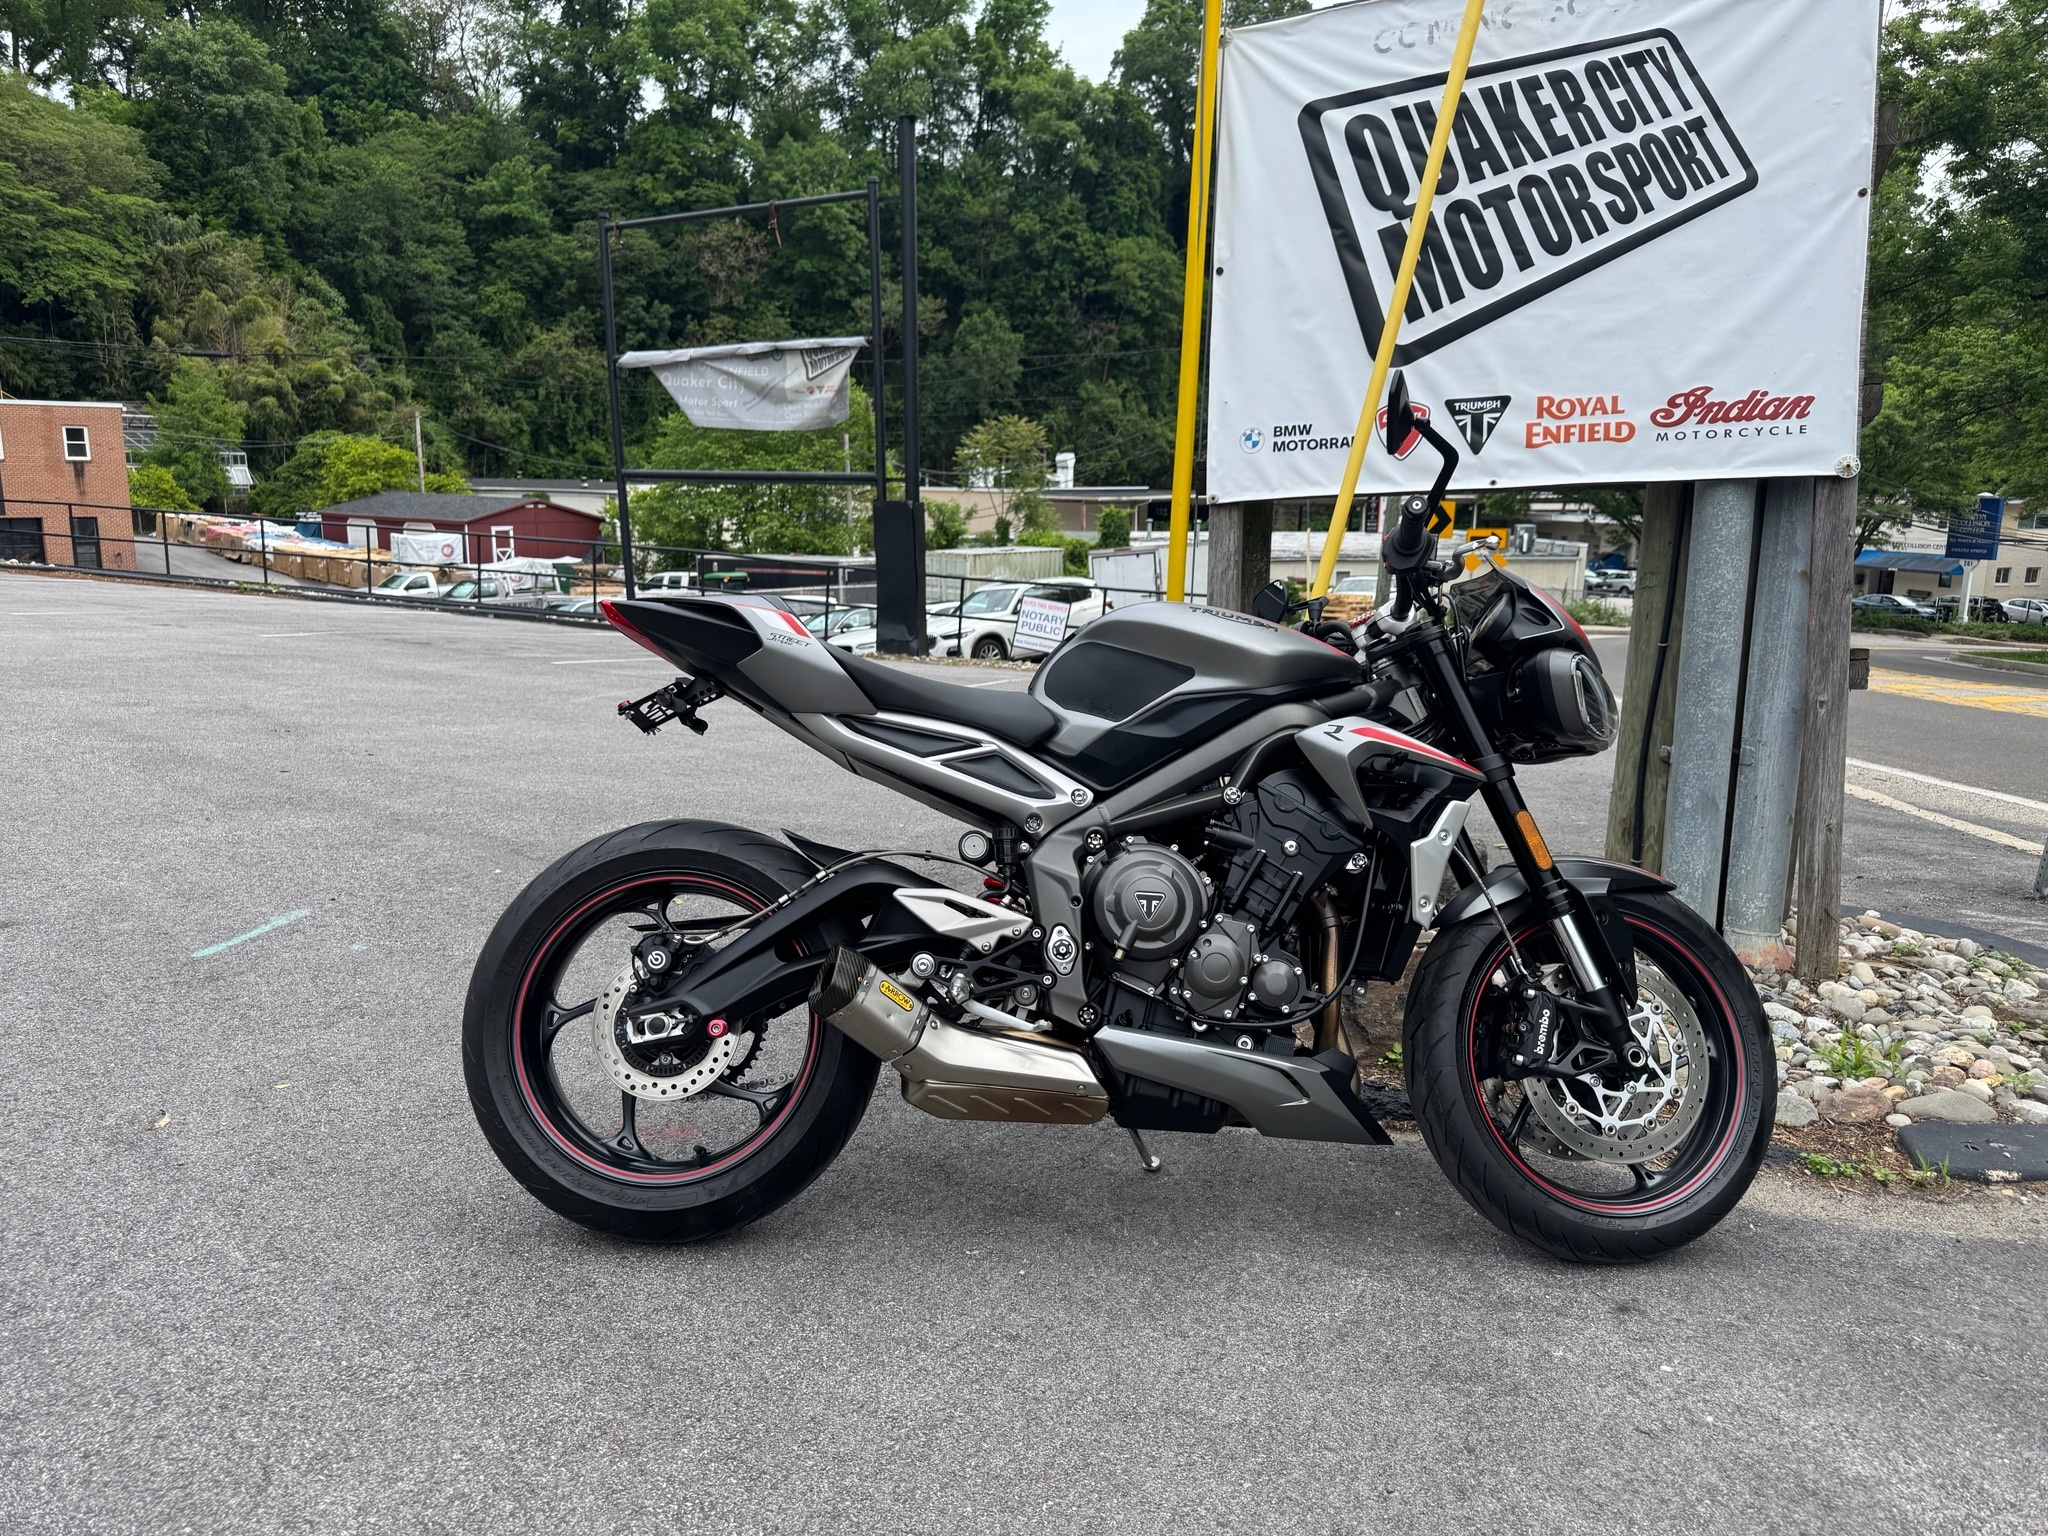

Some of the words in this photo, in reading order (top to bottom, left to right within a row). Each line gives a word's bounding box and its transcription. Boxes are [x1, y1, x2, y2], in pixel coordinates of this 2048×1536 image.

[1344, 69, 1606, 220] QUAKER
[1584, 46, 1694, 134] CITY
[1377, 116, 1729, 324] MOTORSPORT
[661, 372, 712, 388] Quaker
[679, 396, 708, 406] Motor
[712, 396, 738, 408] Sport
[1453, 400, 1501, 413] TRIUMPH
[1536, 396, 1625, 420] ROYAL
[1650, 386, 1816, 428] Indian
[1273, 424, 1313, 437] BMW
[1525, 421, 1636, 449] ENFIELD
[1656, 425, 1807, 442] MOTORCYCLE
[1272, 436, 1356, 452] MOTORRA
[1021, 610, 1065, 626] NOTARY
[1189, 606, 1279, 633] TRIUMPH
[1021, 620, 1061, 636] PUBLIC
[885, 985, 911, 1005] ARROW
[1533, 1009, 1550, 1055] brembo
